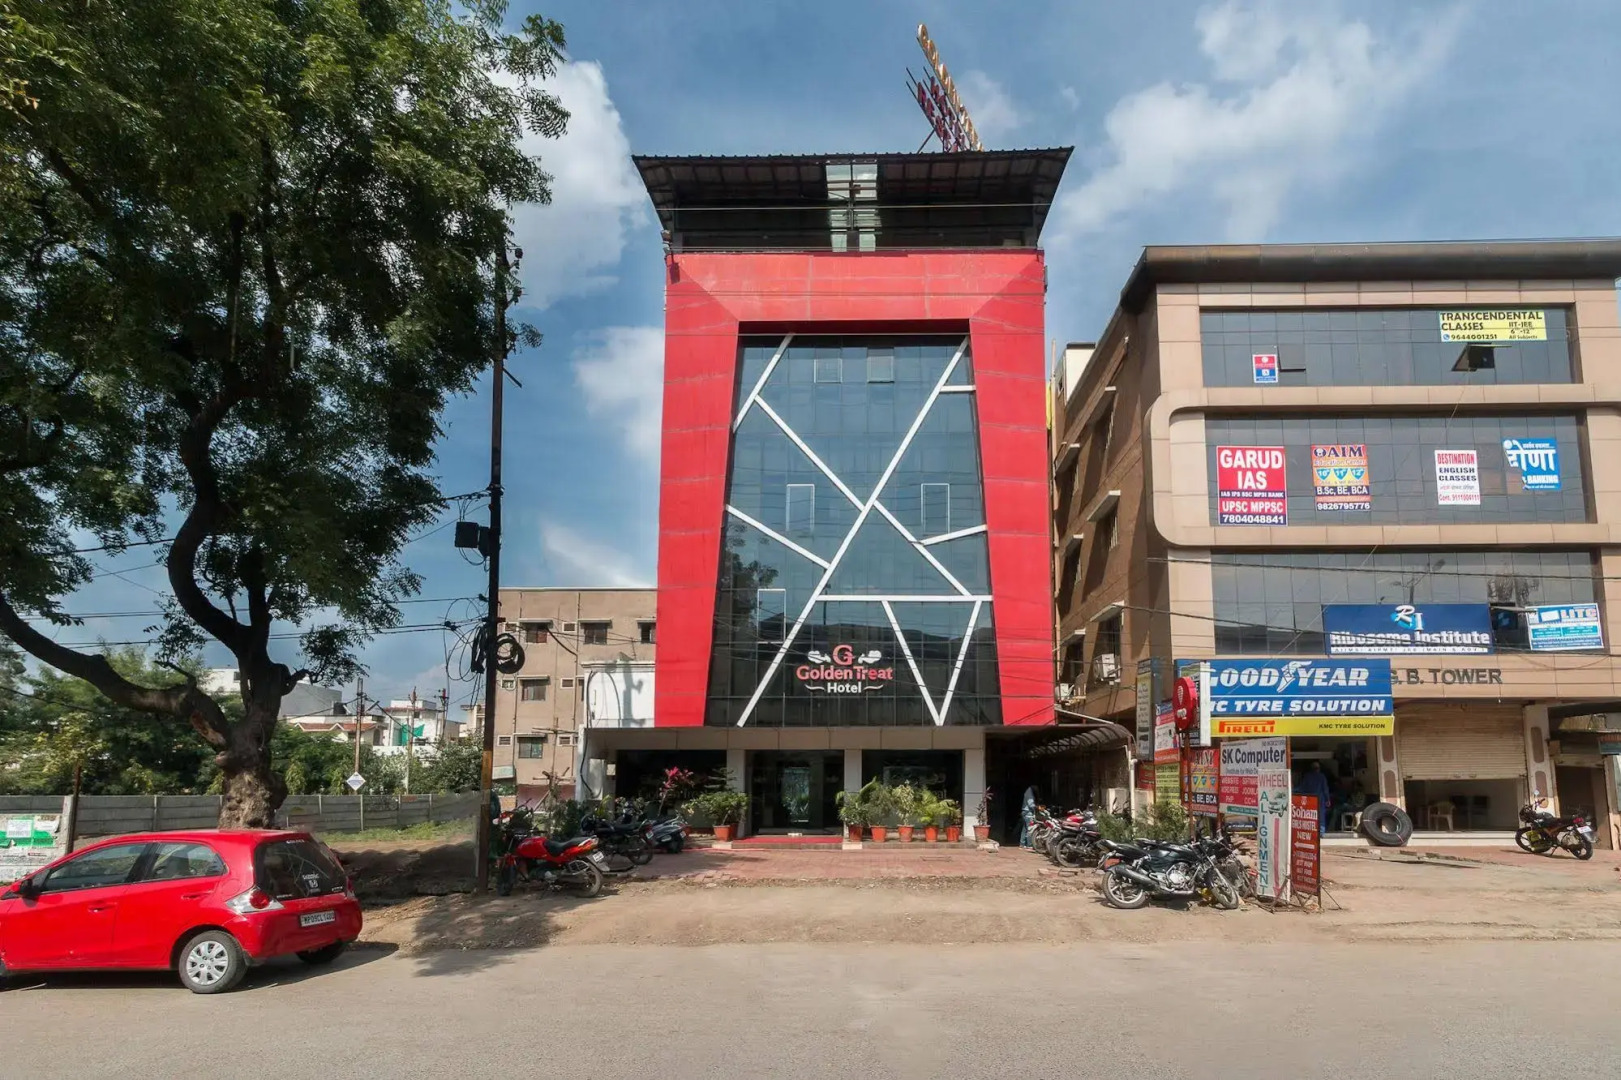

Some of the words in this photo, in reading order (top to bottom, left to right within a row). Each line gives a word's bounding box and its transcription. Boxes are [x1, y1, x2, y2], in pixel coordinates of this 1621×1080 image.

[1440, 311, 1542, 321] TRANSCENDENTAL
[1441, 322, 1484, 331] CLASSES
[1328, 446, 1362, 458] AIM
[1437, 453, 1475, 464] DESTINATION
[1220, 449, 1283, 469] GARUD
[1237, 470, 1268, 490] IAS
[1351, 486, 1368, 494] BCA
[1222, 501, 1248, 512] UPSC
[1250, 502, 1283, 513] MPPSC
[1317, 502, 1370, 510] 9826795776
[1222, 515, 1284, 523] 7804048841
[1330, 631, 1411, 645] Ribosome
[1414, 630, 1490, 645] Institute
[832, 644, 854, 666] G
[796, 665, 853, 681] Golden
[854, 666, 893, 680] Treat
[1428, 668, 1503, 685] TOWER
[827, 682, 862, 693] Hotel
[1234, 701, 1282, 712] TYRE
[1289, 700, 1386, 712] SOLUTION
[1218, 720, 1275, 733] PIRELLI
[1222, 748, 1234, 764] SK
[1234, 747, 1286, 766] Computer
[1259, 774, 1287, 787] WHEEL
[1292, 806, 1318, 820] Soham
[1259, 791, 1269, 895] ALIGNMENT
